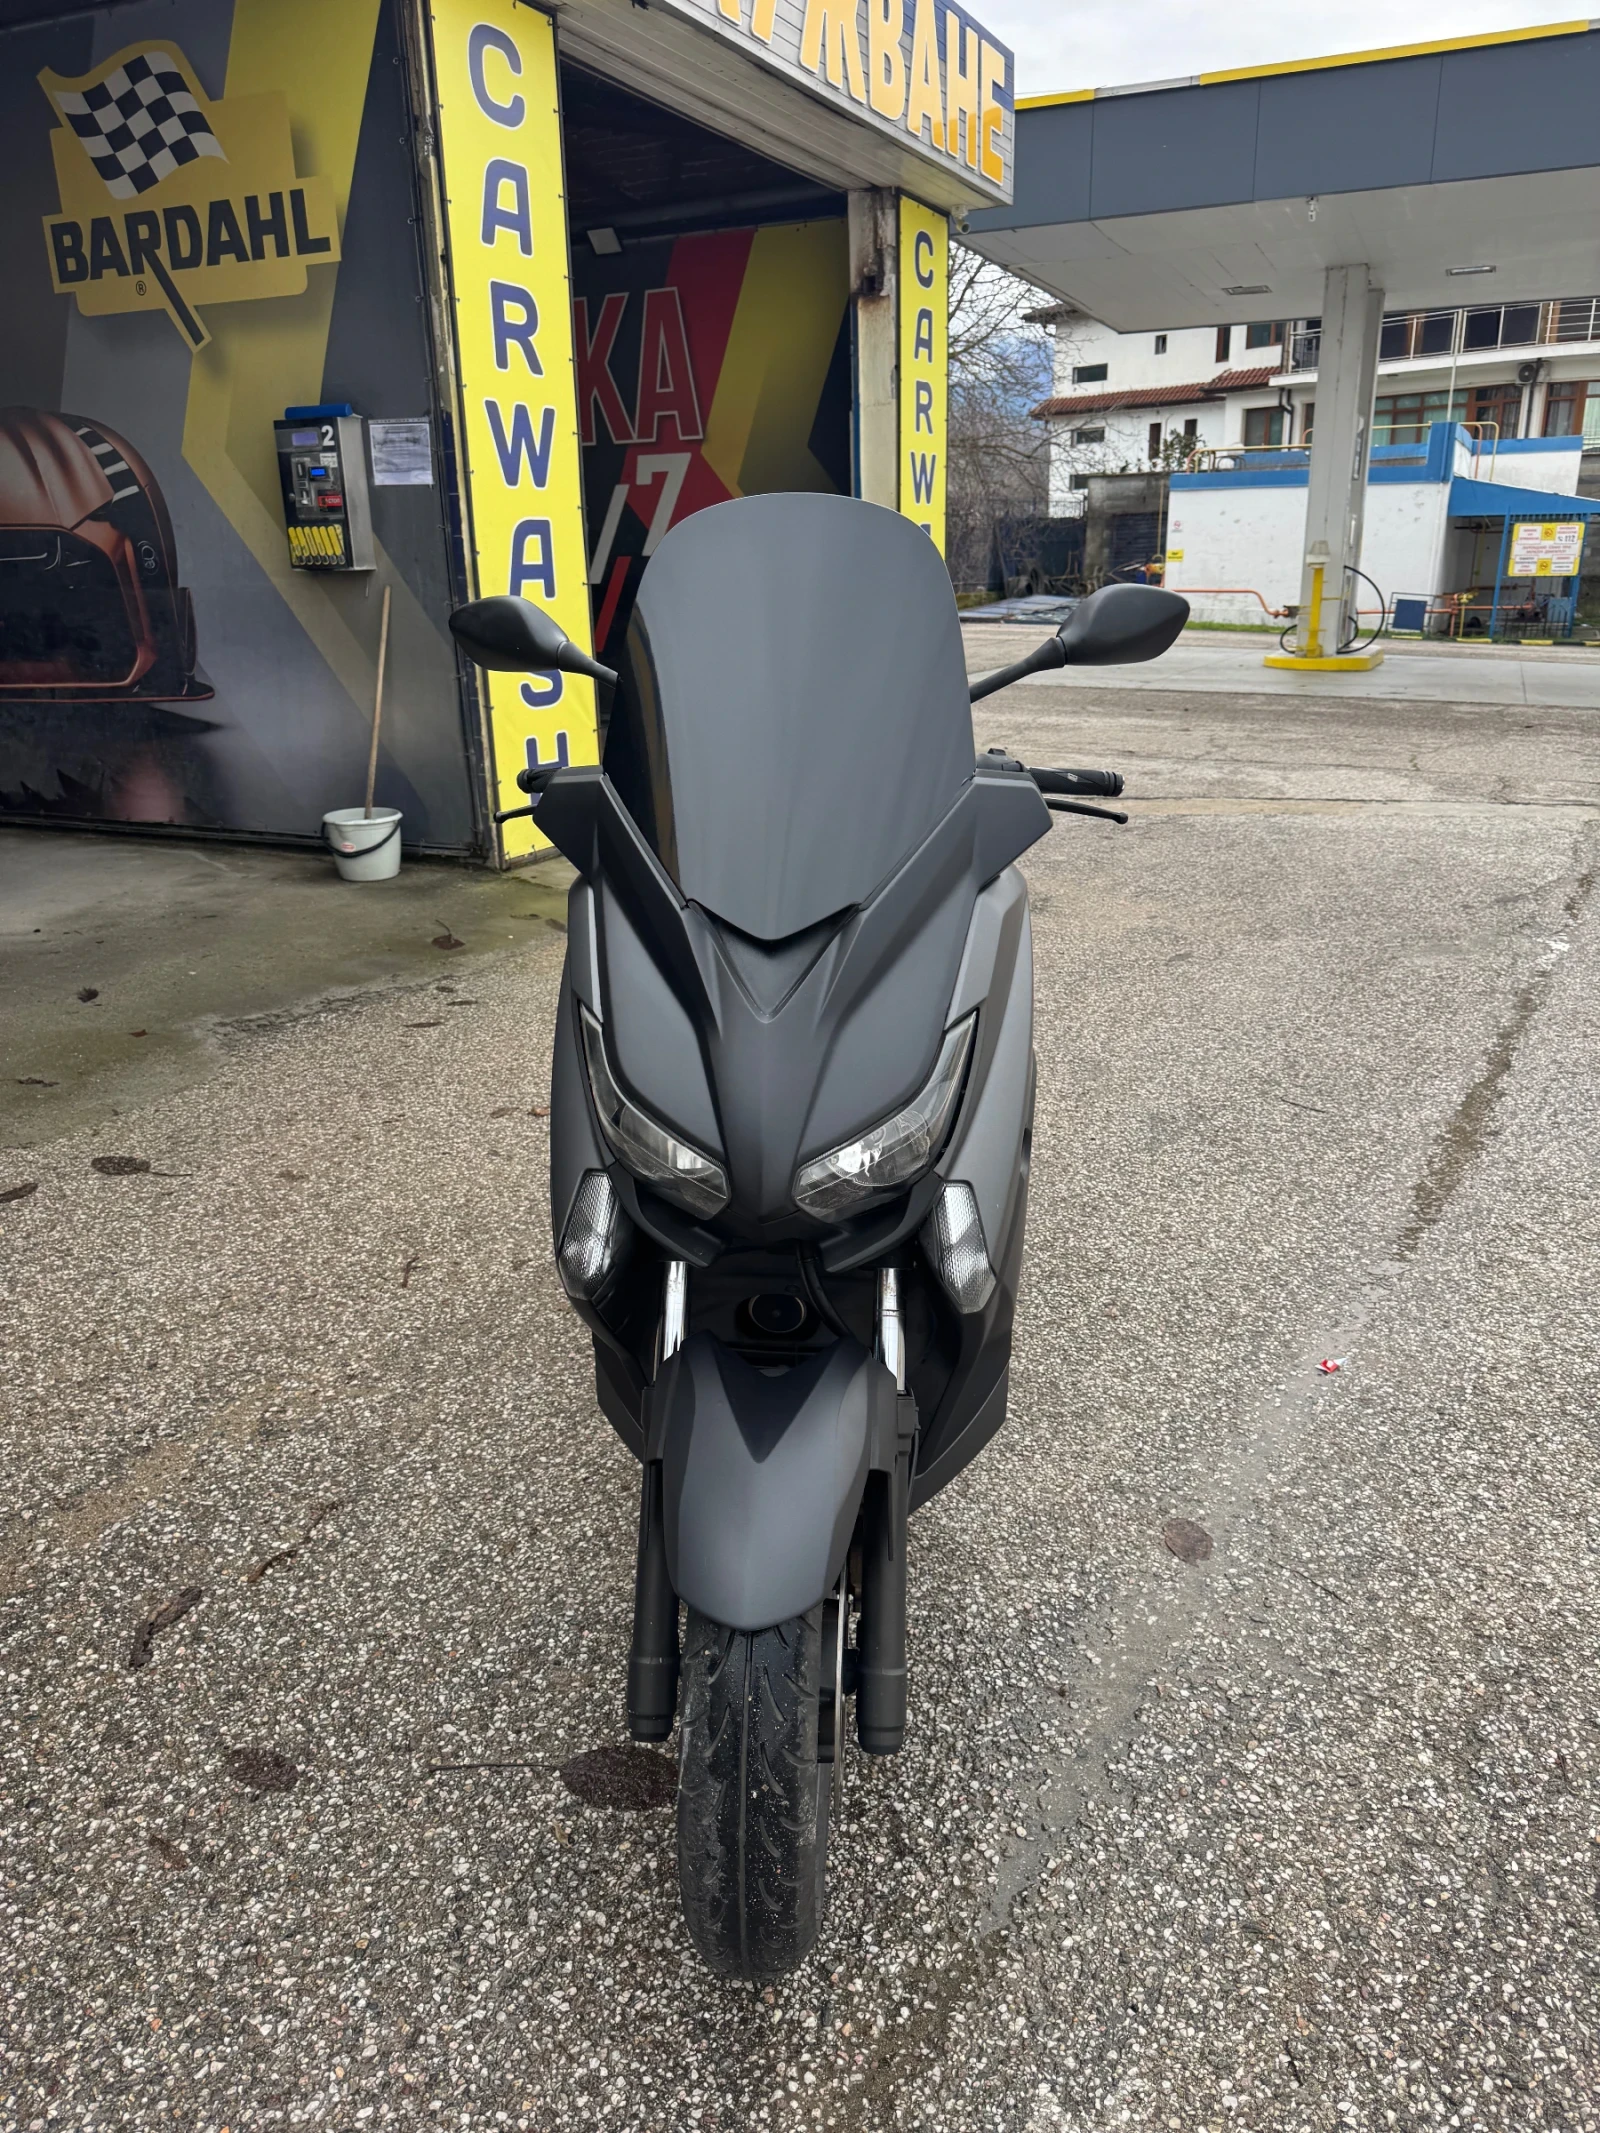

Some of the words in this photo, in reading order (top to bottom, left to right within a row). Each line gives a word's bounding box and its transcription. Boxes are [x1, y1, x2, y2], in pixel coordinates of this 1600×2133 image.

[717, 0, 1005, 186] ЖВАНЕ
[50, 188, 331, 346] BARDAHL
[321, 425, 335, 446] 2
